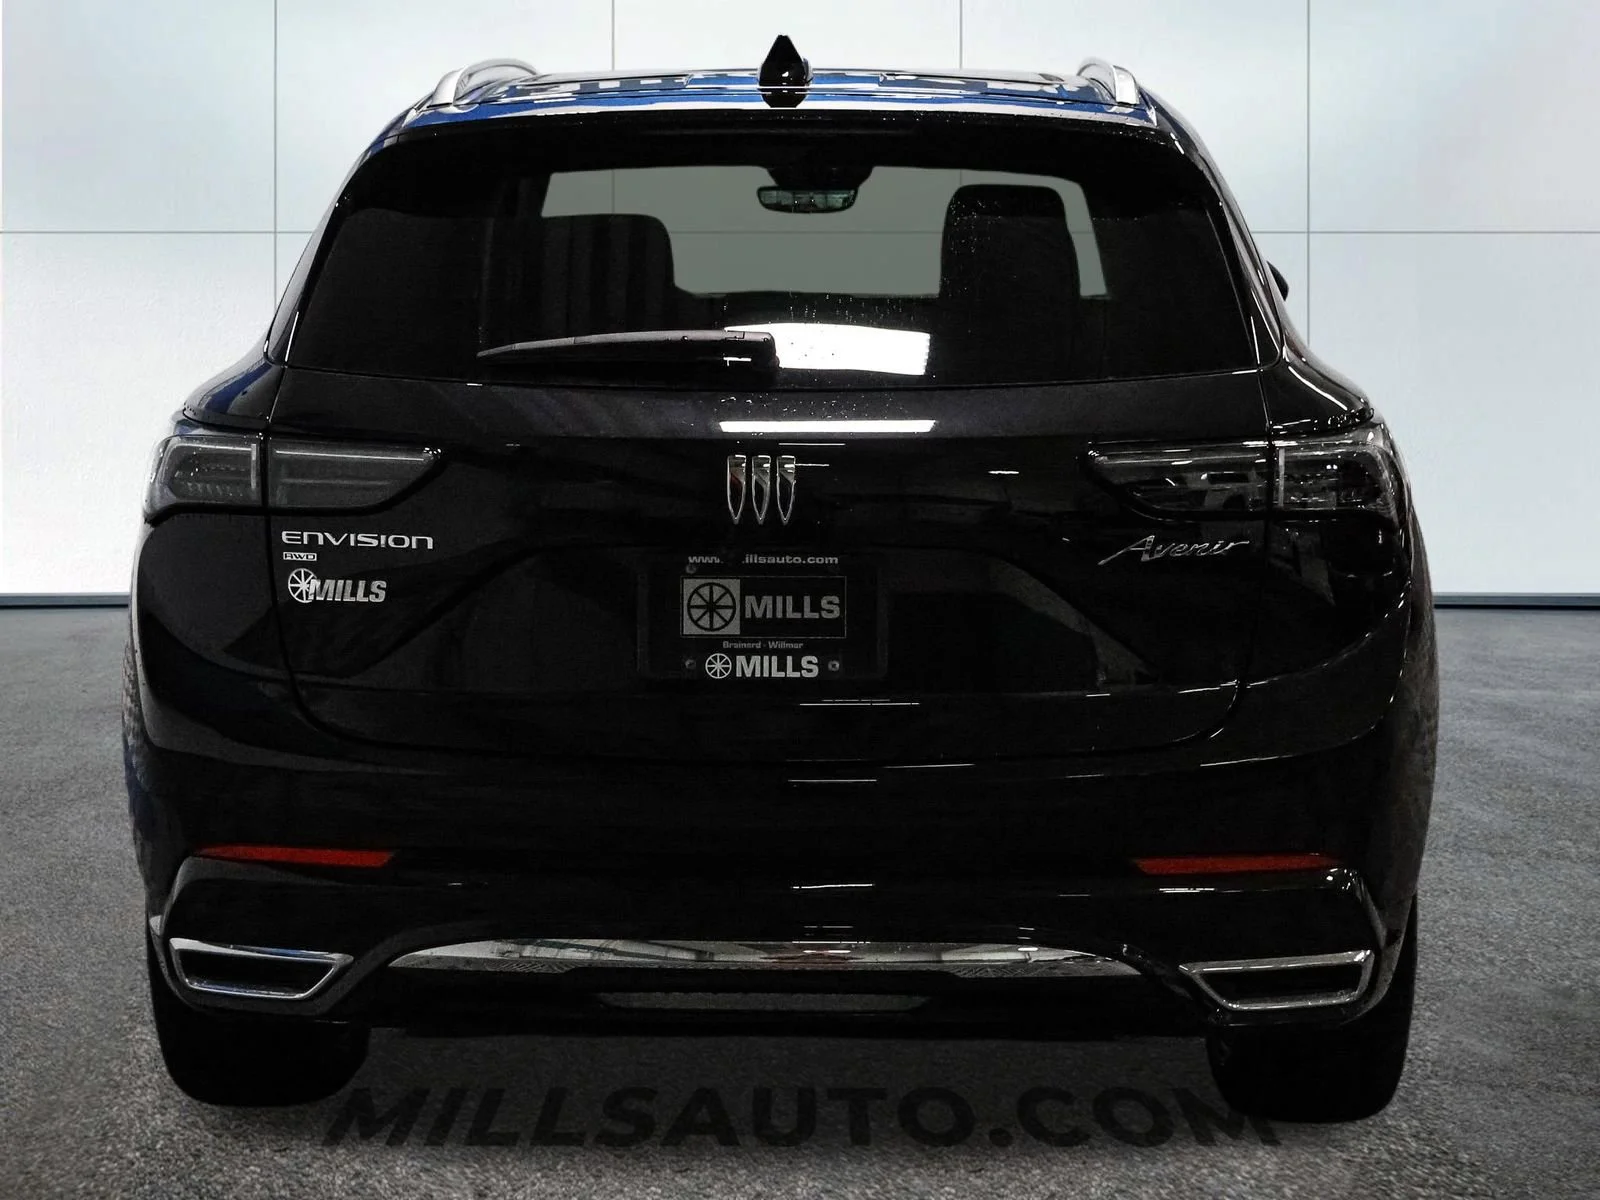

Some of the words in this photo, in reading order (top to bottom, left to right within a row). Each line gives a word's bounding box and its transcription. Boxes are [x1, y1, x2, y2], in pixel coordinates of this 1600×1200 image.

[281, 530, 434, 550] ENVISION
[1098, 534, 1250, 566] Avenir
[283, 552, 317, 561] AWD
[688, 553, 839, 565] www.illsauto.com
[307, 579, 387, 602] MILLS
[744, 595, 841, 619] MILLS
[768, 640, 804, 649] Willmar
[735, 655, 819, 678] MILLS
